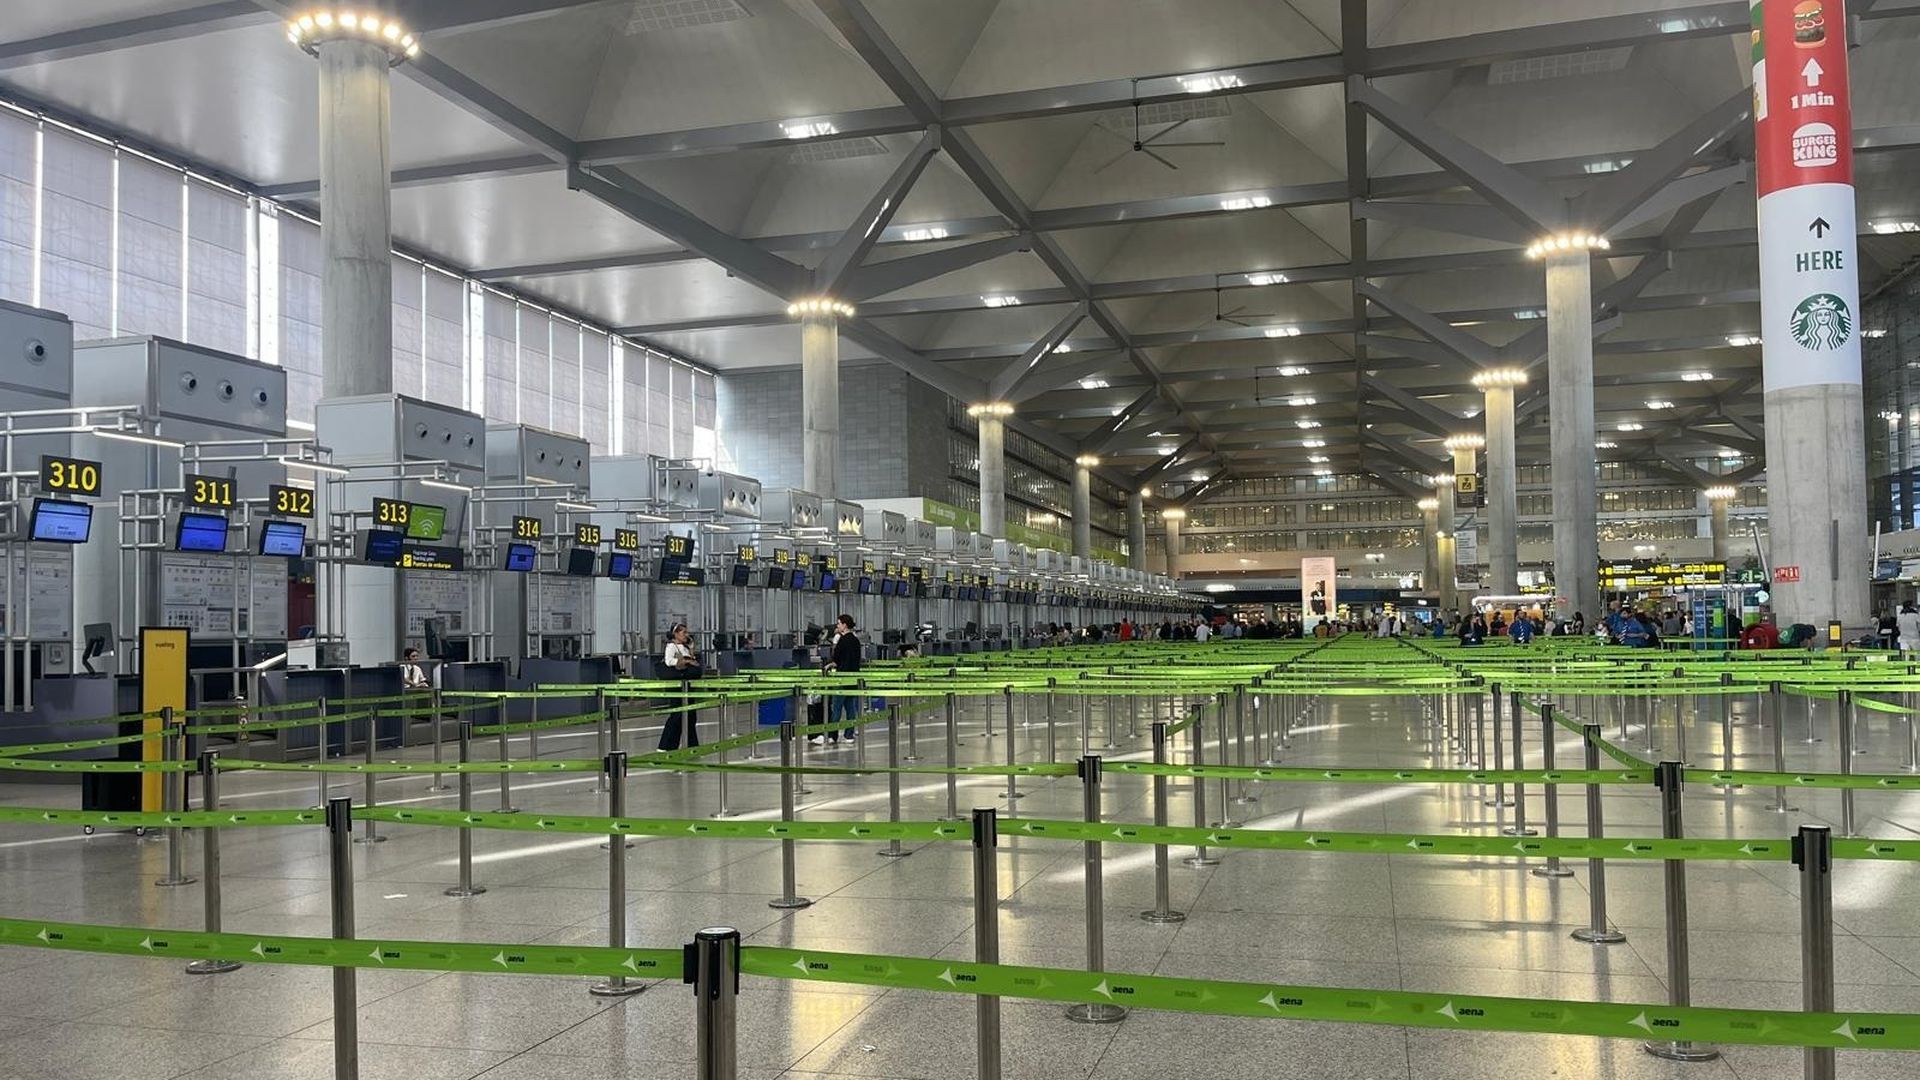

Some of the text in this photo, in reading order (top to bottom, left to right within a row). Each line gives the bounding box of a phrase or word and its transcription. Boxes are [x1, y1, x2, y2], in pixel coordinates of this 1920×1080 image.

[1791, 92, 1834, 109] 1 Min
[1793, 135, 1836, 148] BURGER
[1793, 145, 1837, 161] KING
[1796, 250, 1843, 272] HERE
[48, 461, 97, 491] 310
[194, 480, 231, 505] 311
[277, 490, 310, 513] 312
[380, 502, 407, 523] 313
[518, 520, 539, 538] 314
[580, 526, 599, 544] 315
[619, 532, 637, 548] 316
[670, 538, 684, 552] 317
[741, 547, 753, 560] 318
[637, 960, 657, 968] aena
[1279, 997, 1303, 1005] aena
[1458, 1008, 1484, 1016] aena
[1652, 1018, 1680, 1026] aena
[1856, 1027, 1886, 1035] aena
